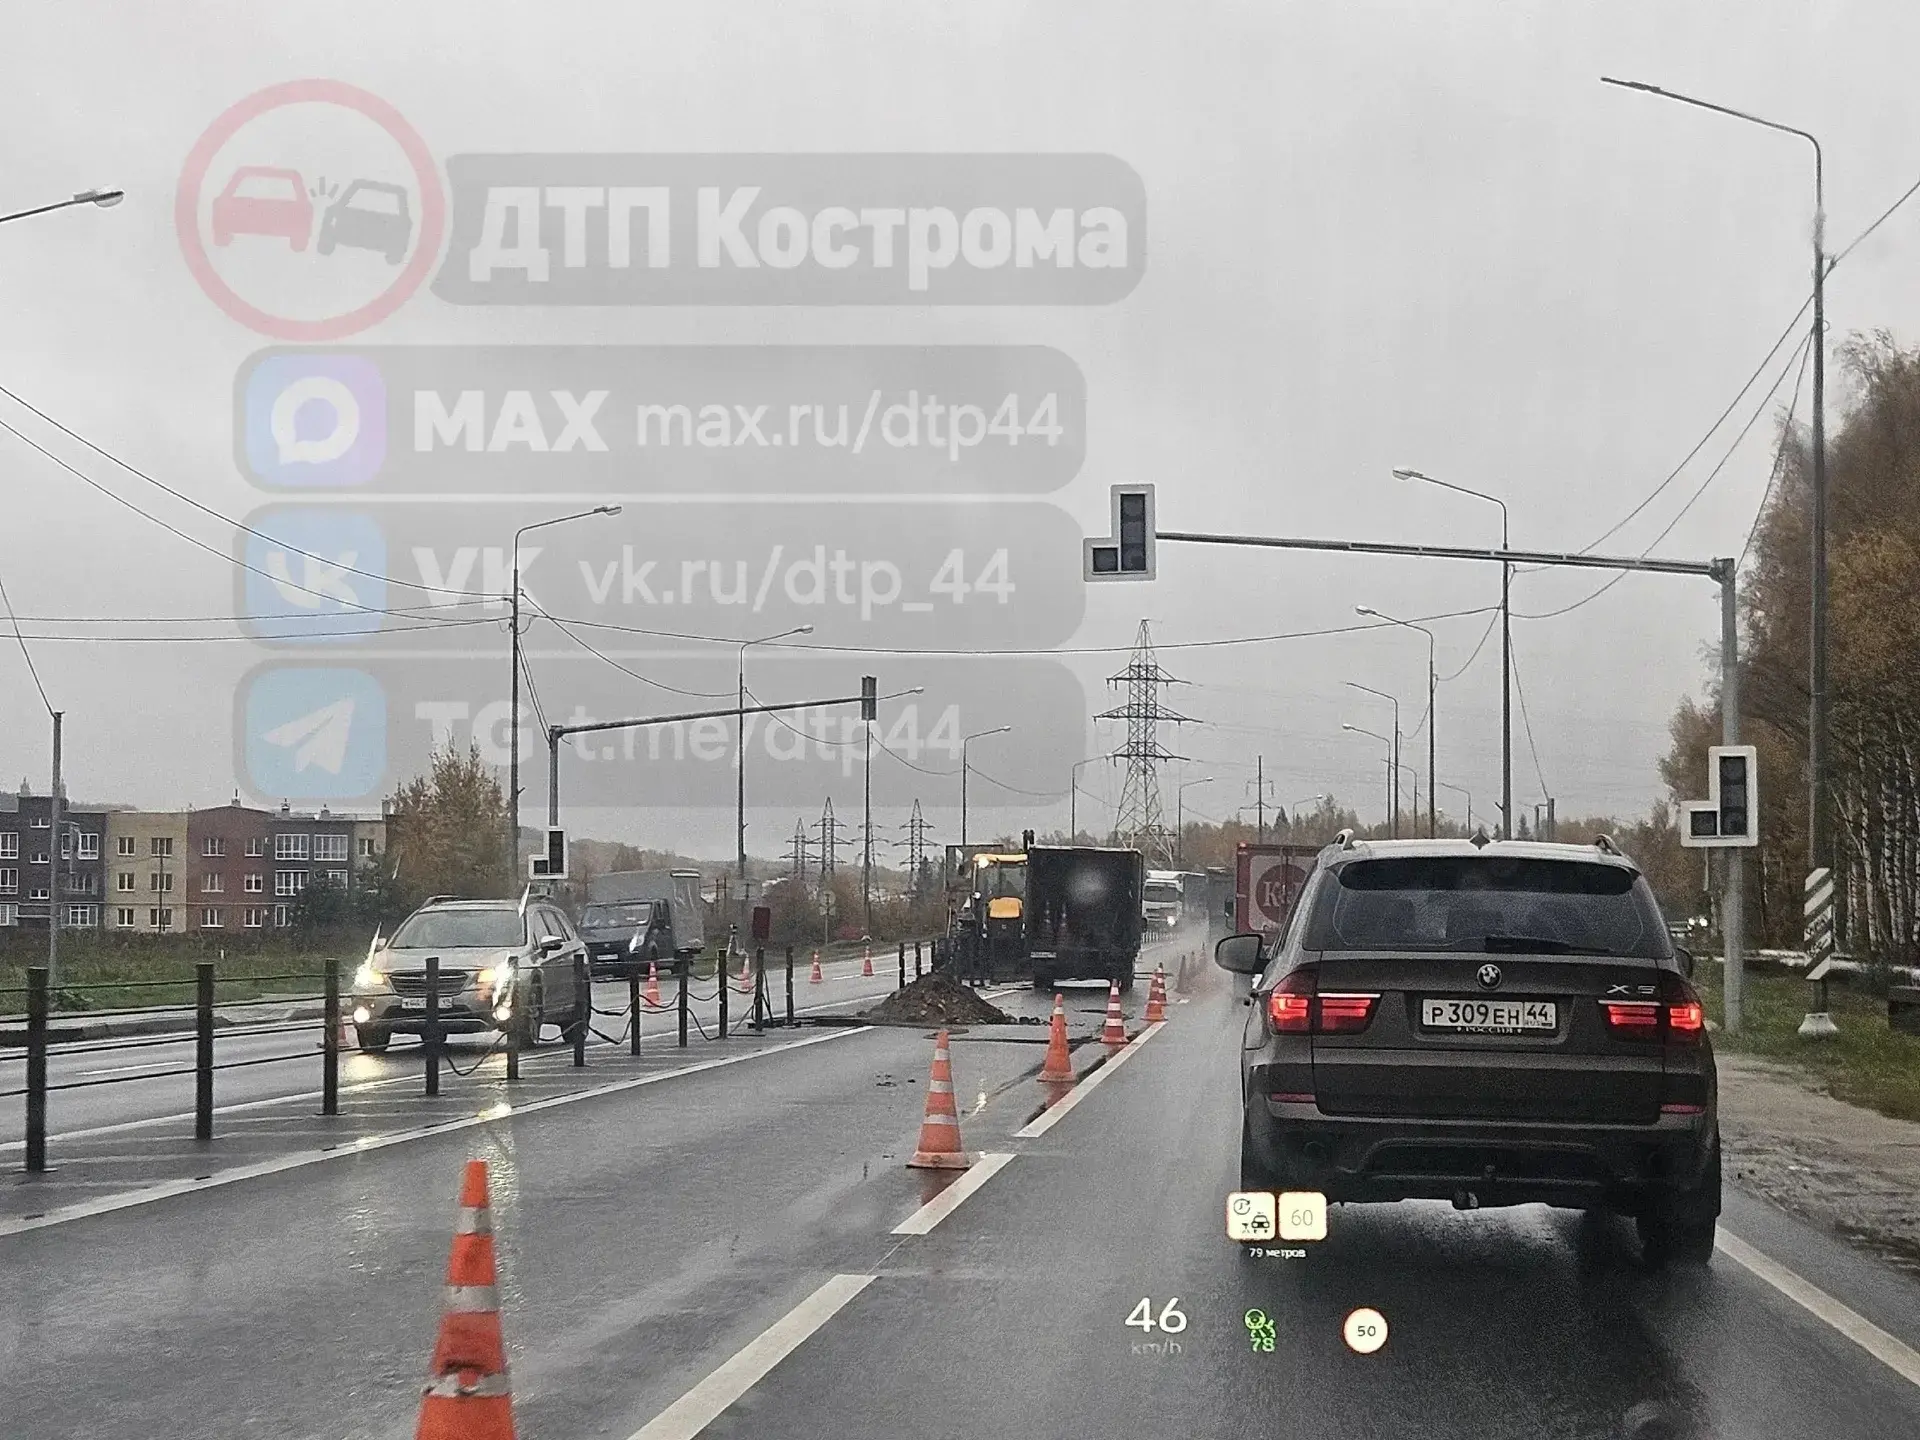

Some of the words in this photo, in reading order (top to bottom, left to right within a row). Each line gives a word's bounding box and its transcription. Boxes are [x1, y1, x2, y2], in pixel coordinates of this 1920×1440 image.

[1291, 1209, 1313, 1226] 60
[1249, 1248, 1263, 1258] 79
[1124, 1297, 1188, 1333] 46
[1357, 1325, 1376, 1337] 50
[1131, 1338, 1182, 1355] km/h
[1251, 1338, 1275, 1352] 78
